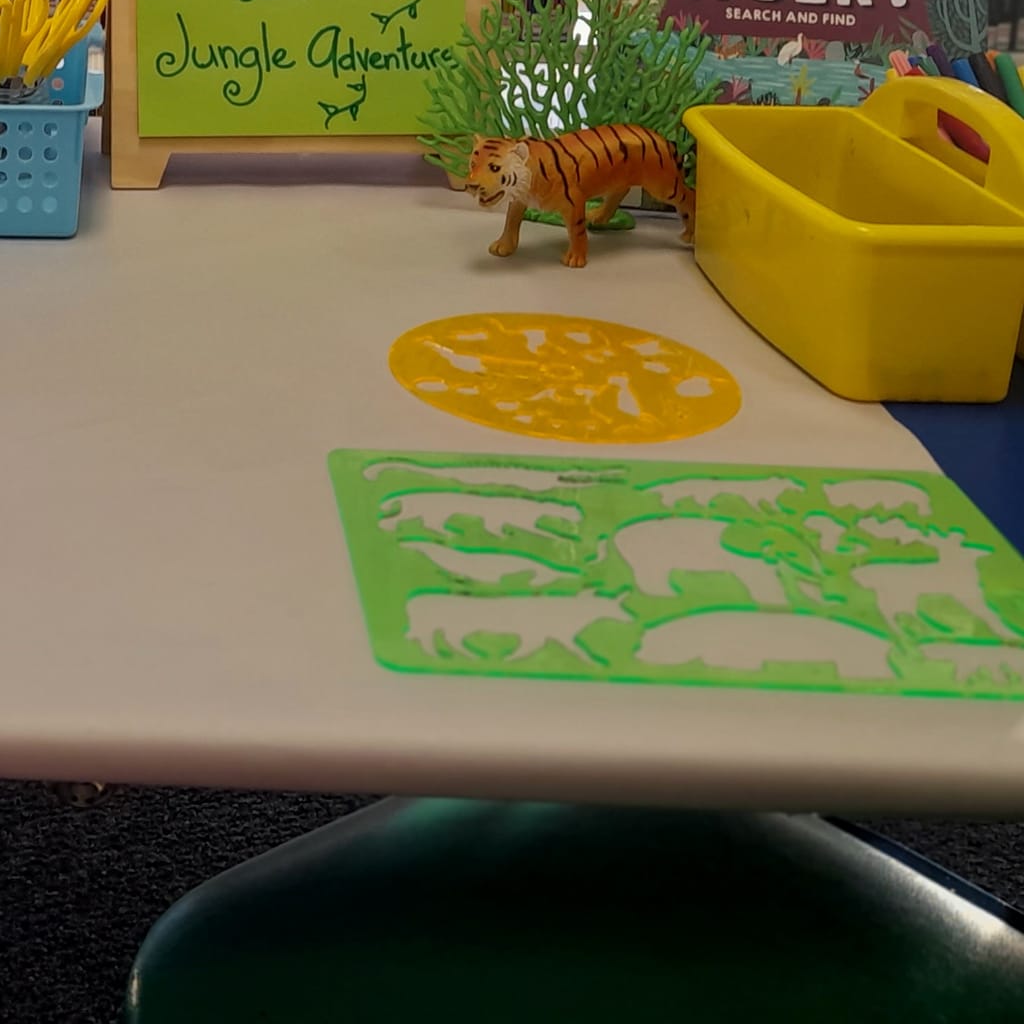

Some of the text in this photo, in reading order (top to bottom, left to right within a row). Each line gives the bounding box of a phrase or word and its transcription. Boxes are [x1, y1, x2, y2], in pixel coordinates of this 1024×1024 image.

[725, 6, 857, 27] SEARCH AND FIND
[156, 12, 296, 107] Jungle
